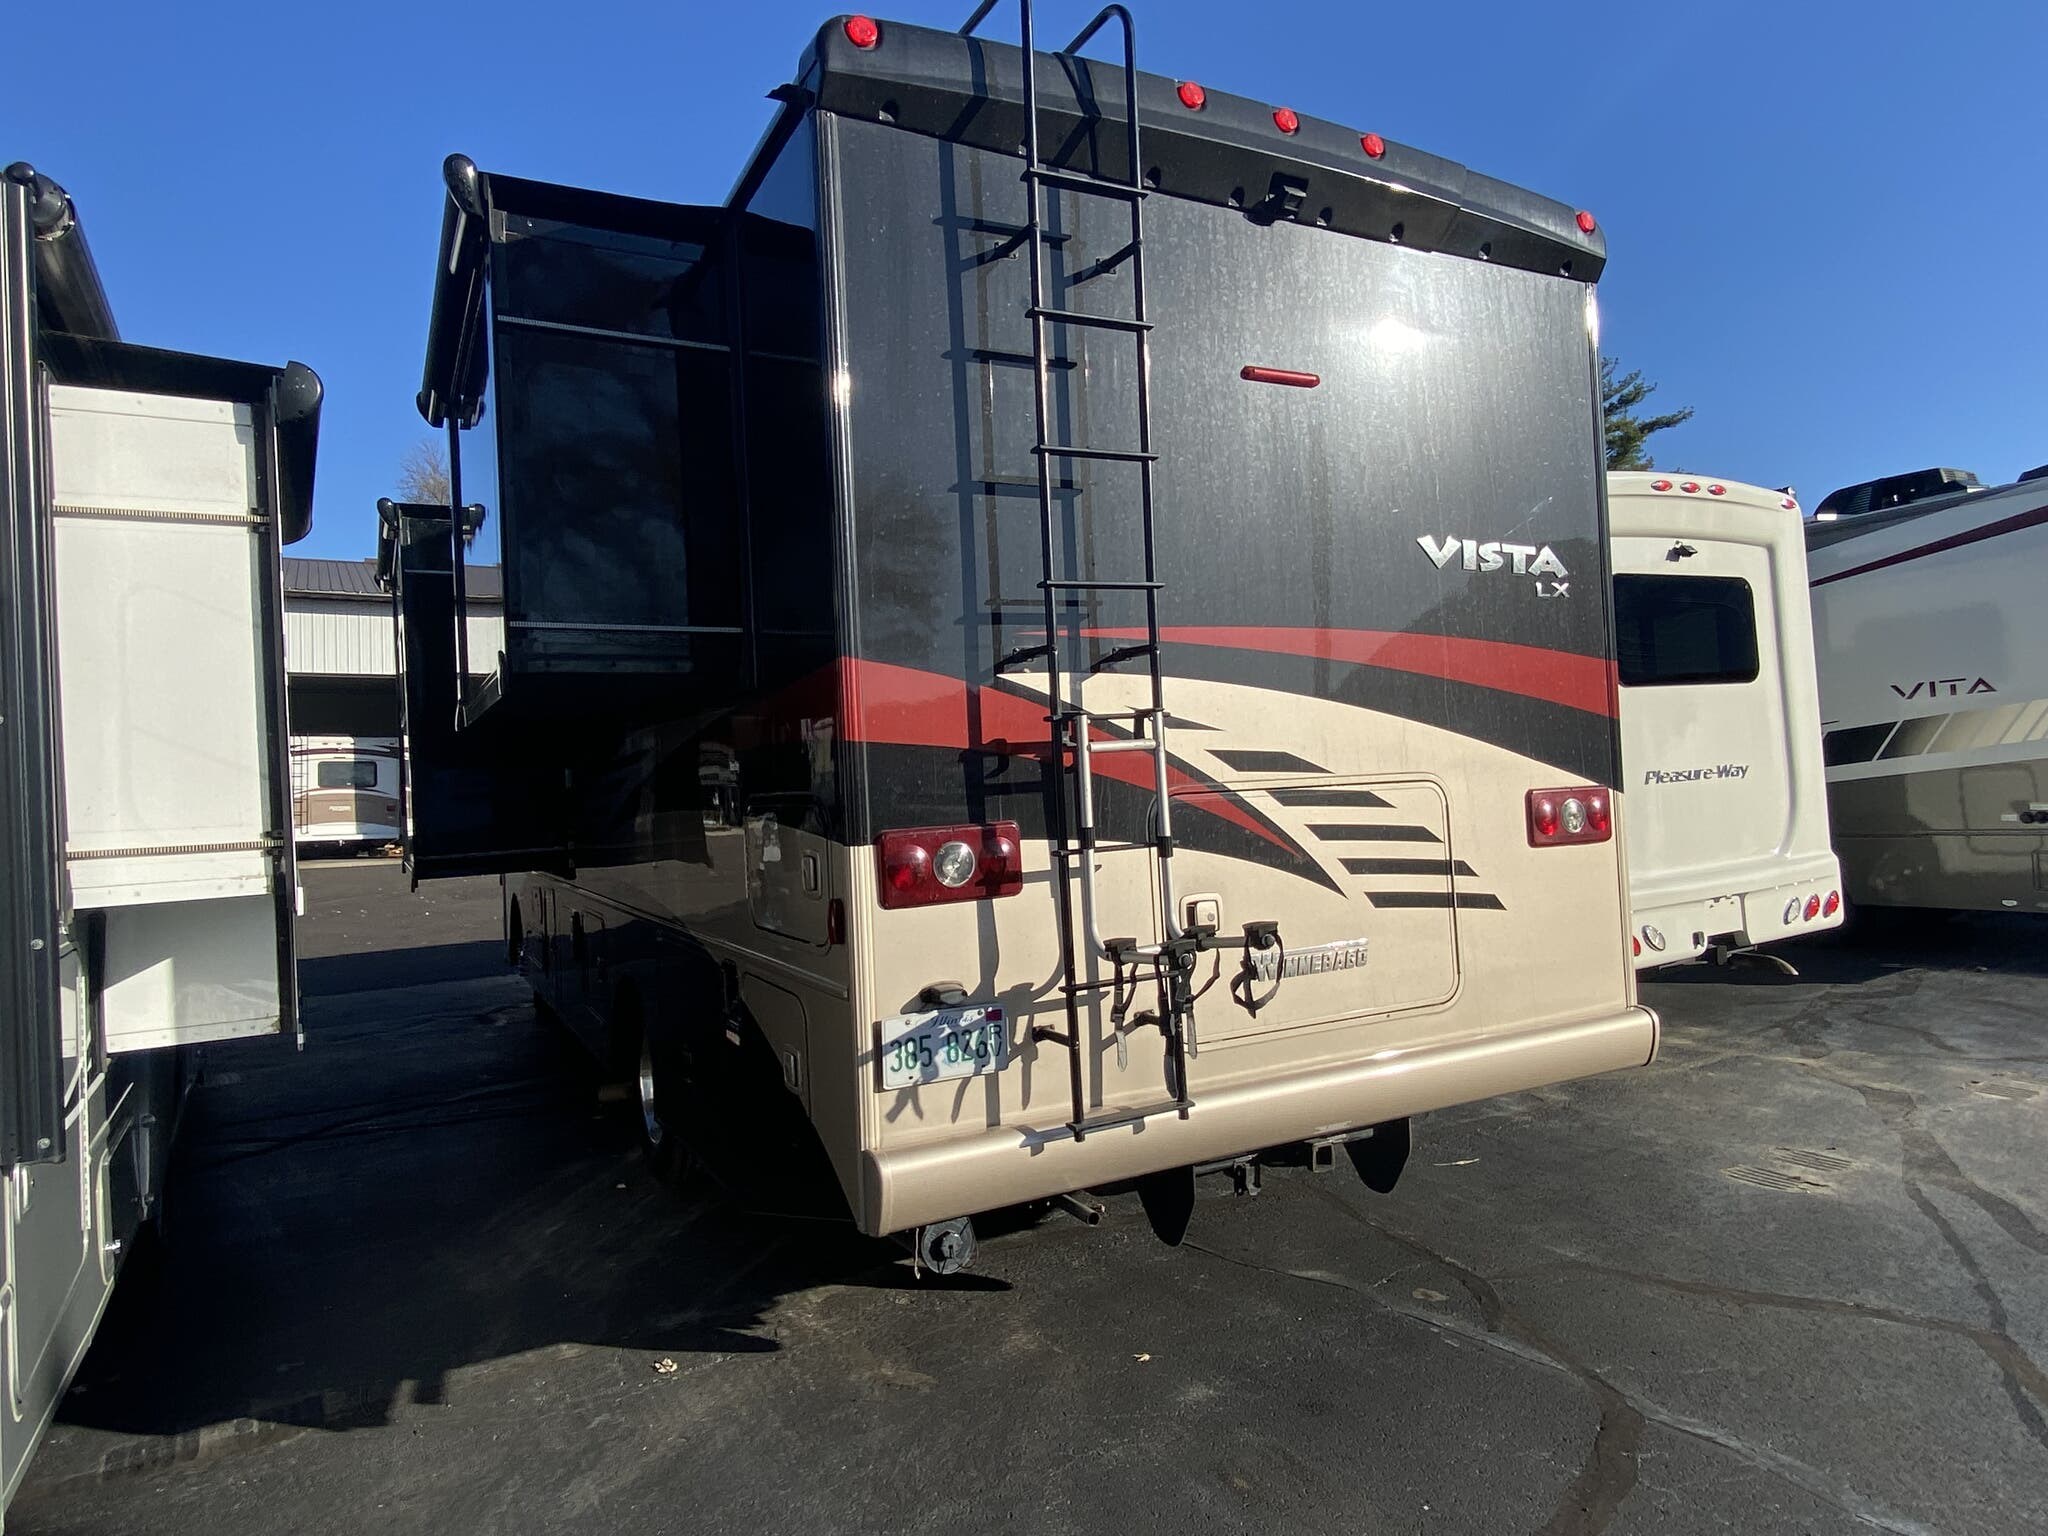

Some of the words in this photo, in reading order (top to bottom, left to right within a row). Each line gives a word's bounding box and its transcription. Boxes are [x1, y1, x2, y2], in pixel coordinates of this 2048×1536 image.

[1416, 534, 1569, 578] VISTA
[1535, 581, 1570, 598] LX
[1890, 677, 1997, 699] VITA
[1644, 764, 1749, 785] Pleasure-Way
[1250, 946, 1369, 982] WNNEBAGO
[890, 1034, 932, 1073] 385
[946, 1029, 988, 1063] 826
